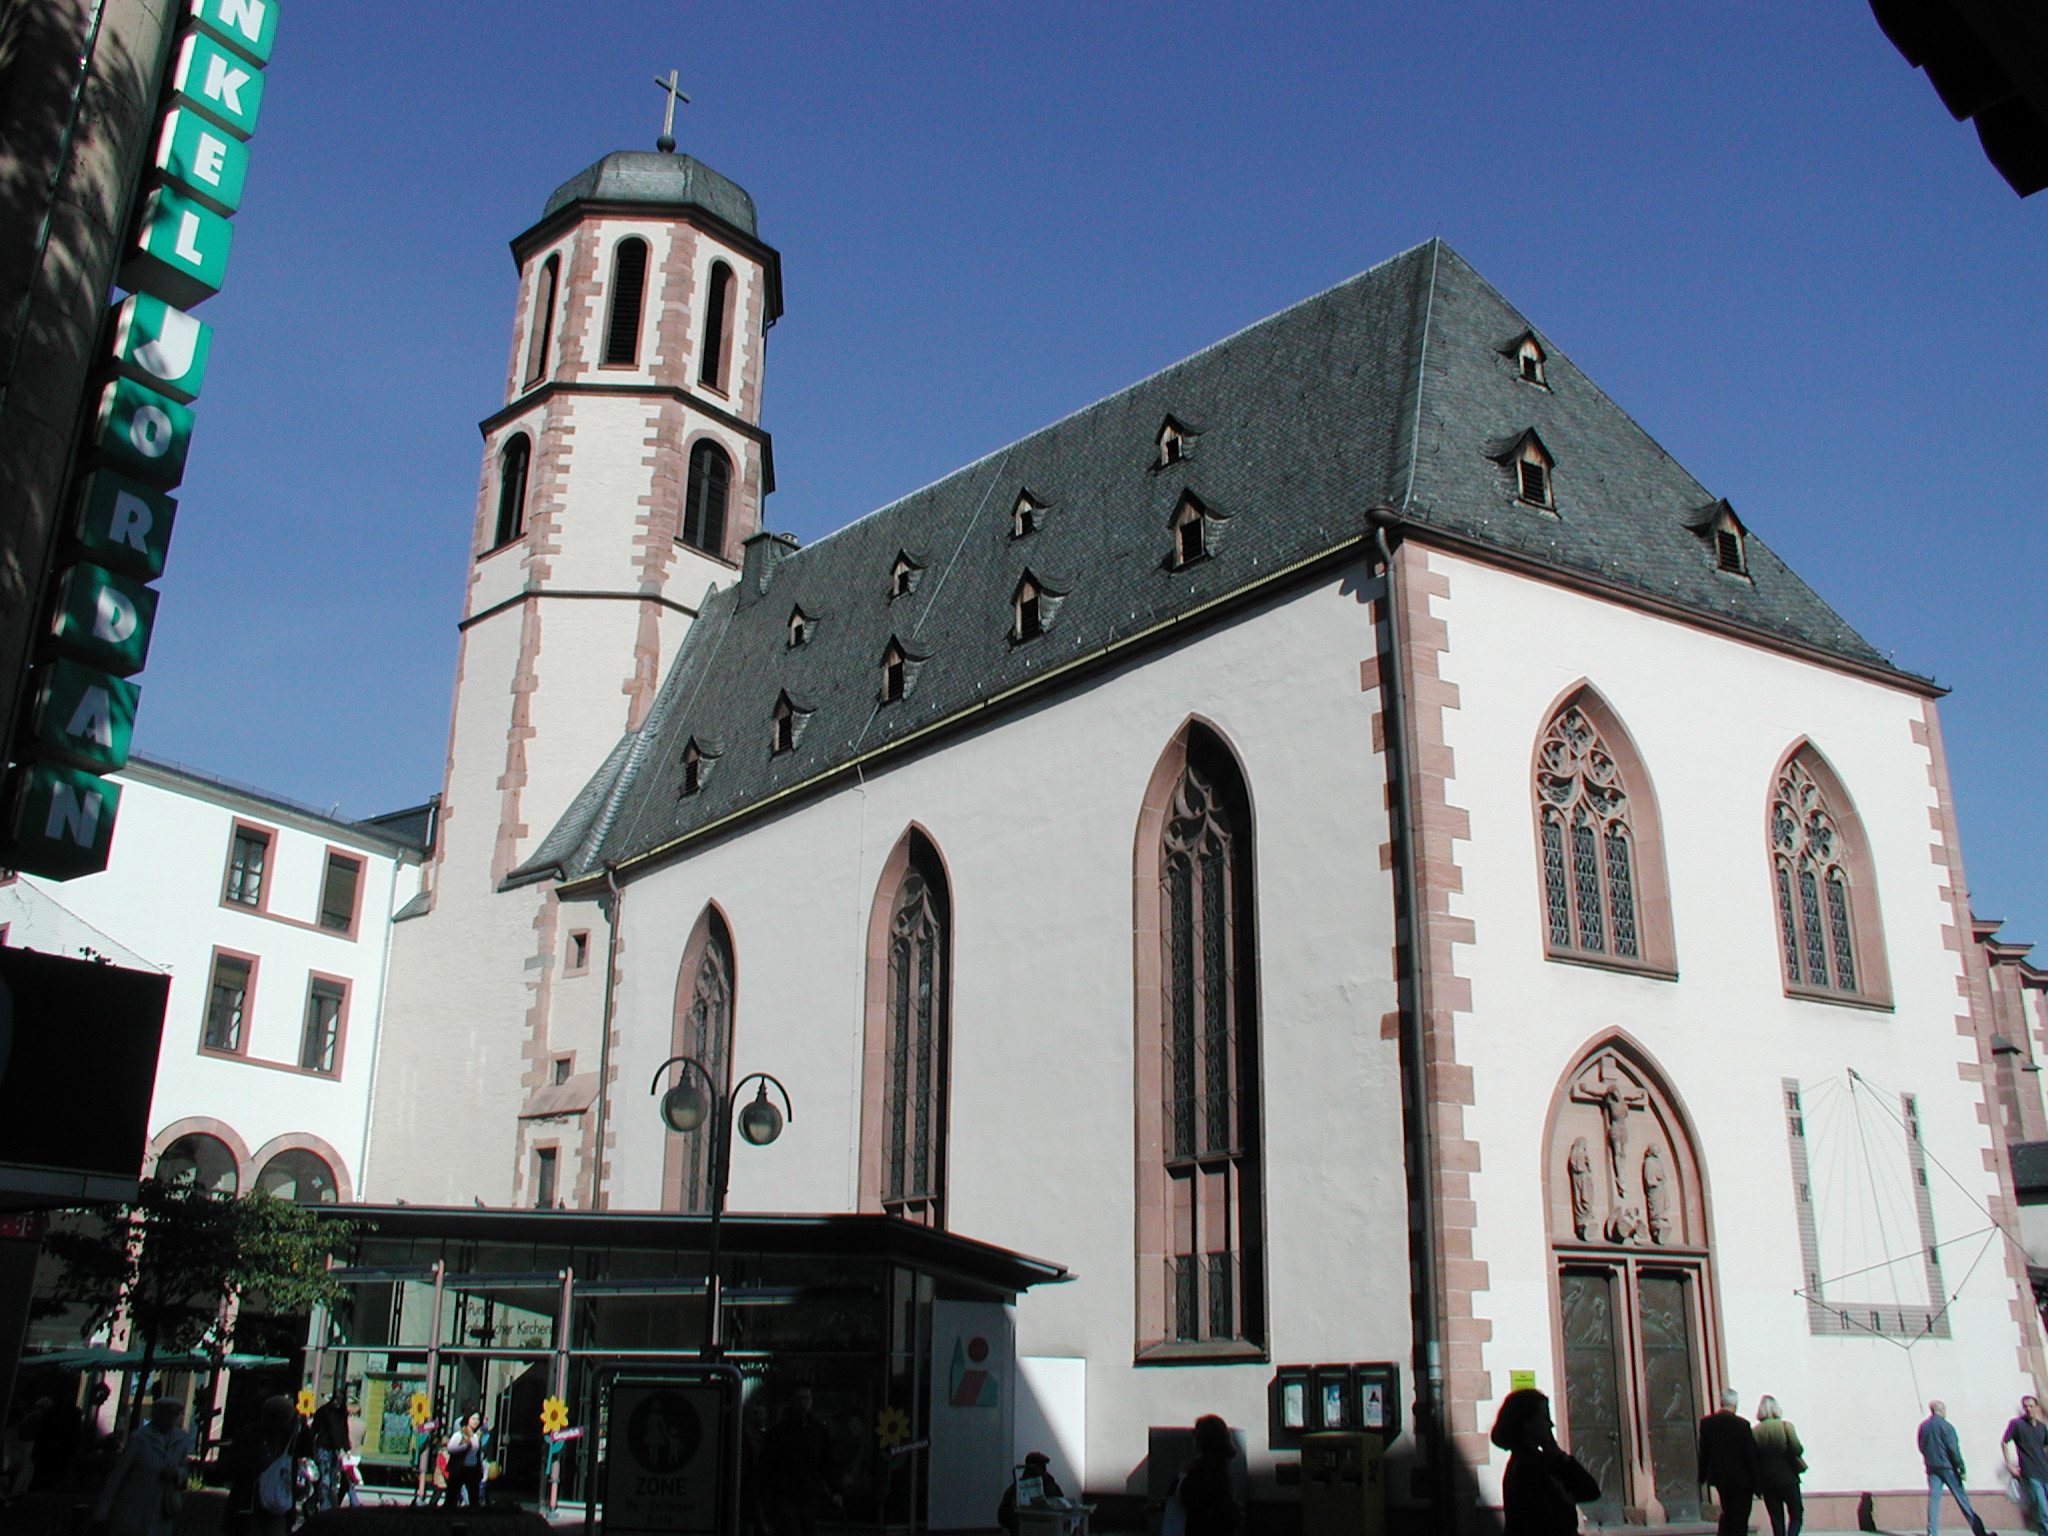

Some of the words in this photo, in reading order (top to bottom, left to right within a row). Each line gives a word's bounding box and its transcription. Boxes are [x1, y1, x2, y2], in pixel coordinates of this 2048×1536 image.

[45, 305, 201, 849] JORDAN
[517, 1318, 553, 1335] Kirchen
[635, 1476, 688, 1496] ZONE
